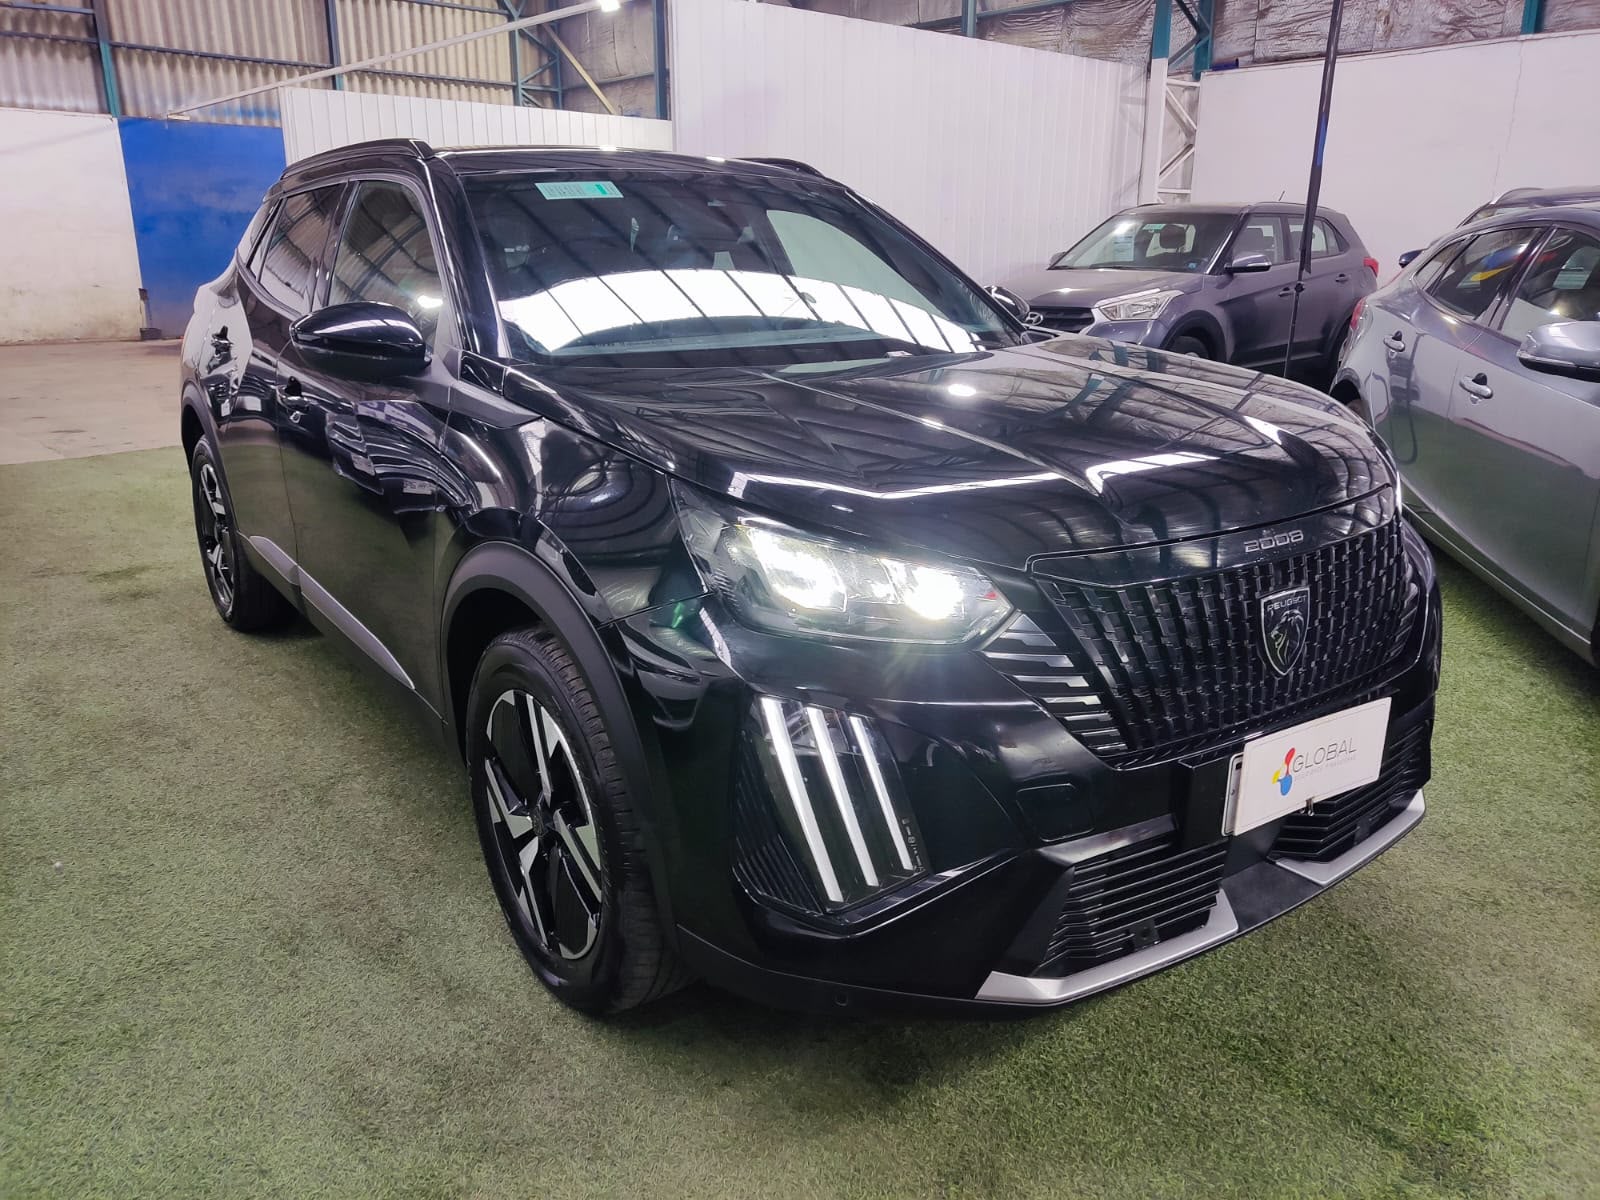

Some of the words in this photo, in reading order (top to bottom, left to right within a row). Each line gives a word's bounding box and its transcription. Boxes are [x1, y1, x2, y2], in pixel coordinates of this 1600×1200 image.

[1244, 530, 1304, 552] 2008
[1267, 595, 1307, 611] PEUGEOT
[1293, 738, 1356, 773] GLOBAL
